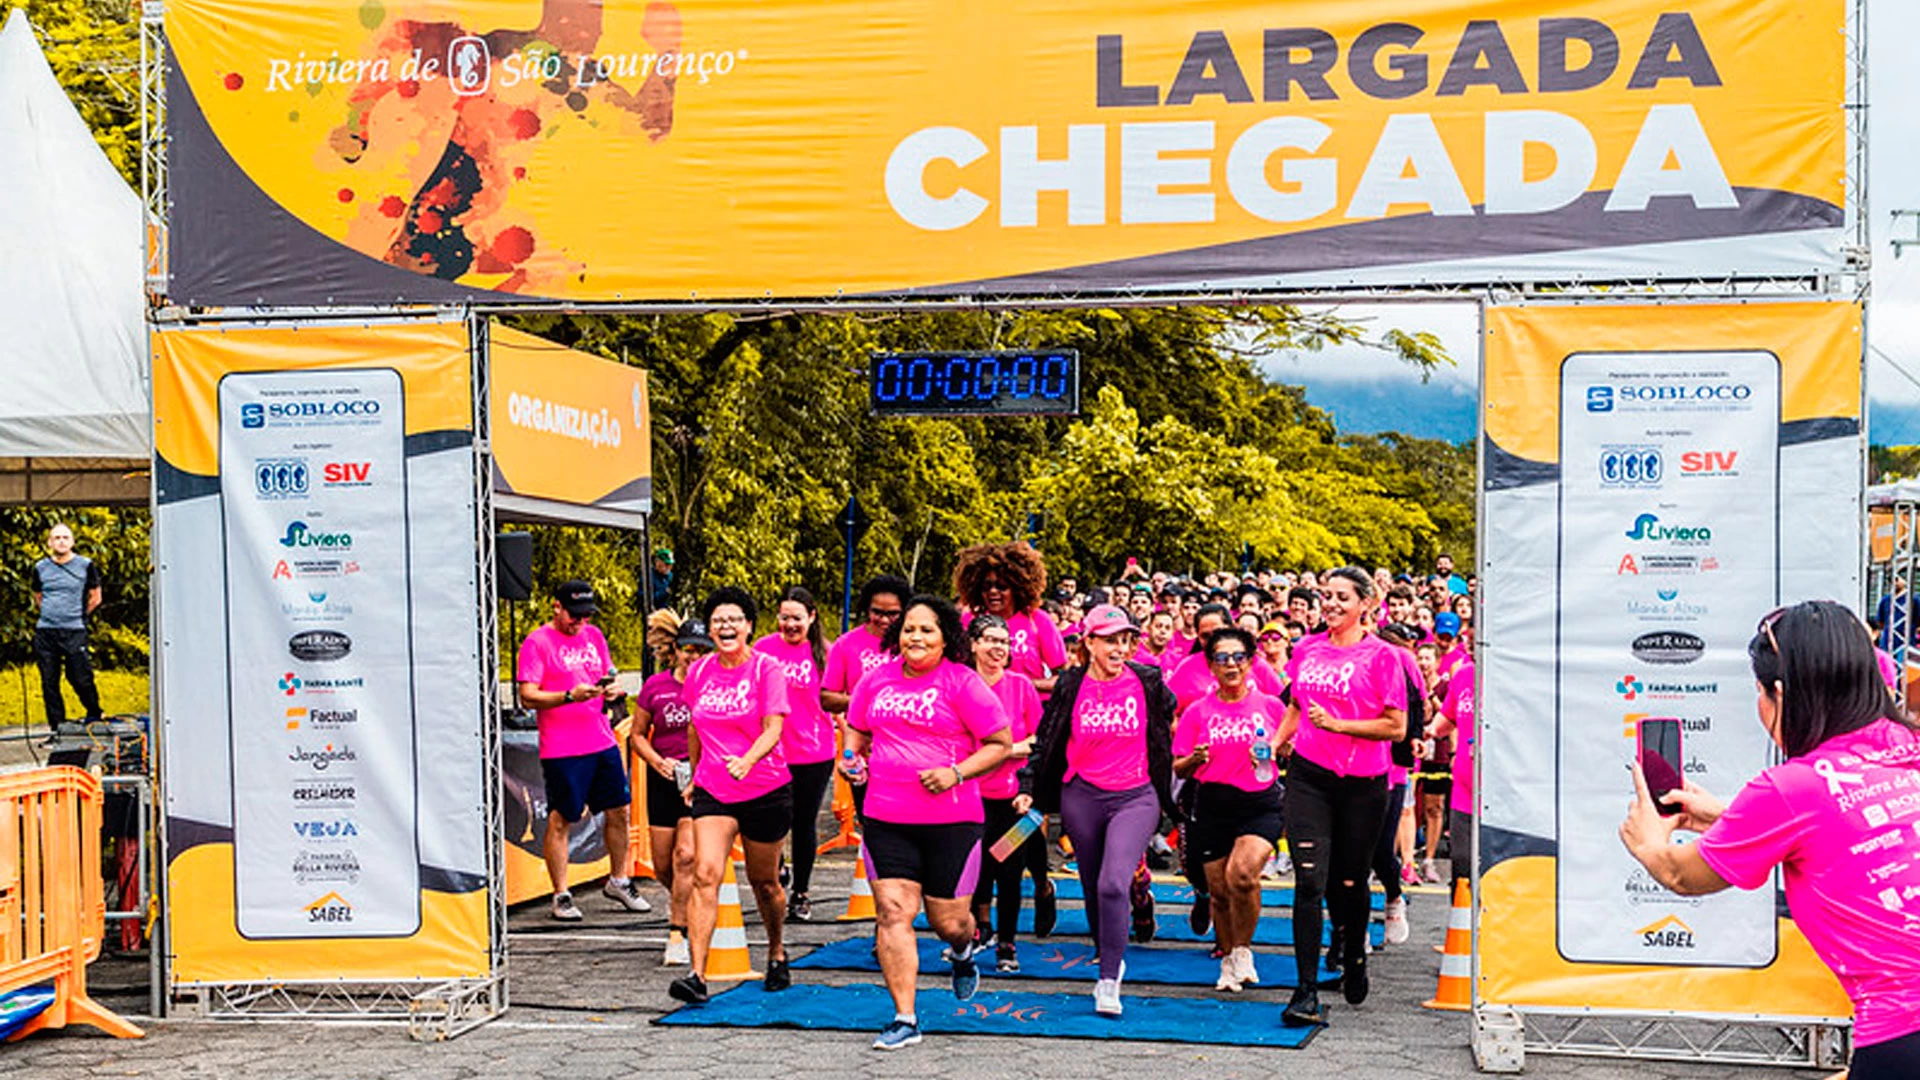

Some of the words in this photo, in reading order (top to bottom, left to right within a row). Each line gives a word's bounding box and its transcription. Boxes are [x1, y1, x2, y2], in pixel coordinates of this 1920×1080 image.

[1095, 12, 1723, 108] LARGADA
[266, 50, 389, 92] Riviera
[400, 49, 438, 83] de
[500, 48, 560, 88] São
[884, 103, 1740, 231] CHEGADA
[1620, 385, 1752, 401] SOBLOCO
[269, 400, 380, 417] SOBLOCO
[508, 391, 621, 449] ORGANIZAÇÃO
[1681, 451, 1737, 472] SIV
[324, 462, 371, 482] SIV
[310, 709, 357, 722] Factual
[1080, 713, 1123, 727] ROSA
[1209, 725, 1253, 739] ROSA
[1681, 718, 1710, 731] tual
[288, 745, 357, 770] Jangada
[294, 822, 358, 837] VEJA
[309, 906, 352, 923] SABEL
[1643, 931, 1695, 948] SABEL
